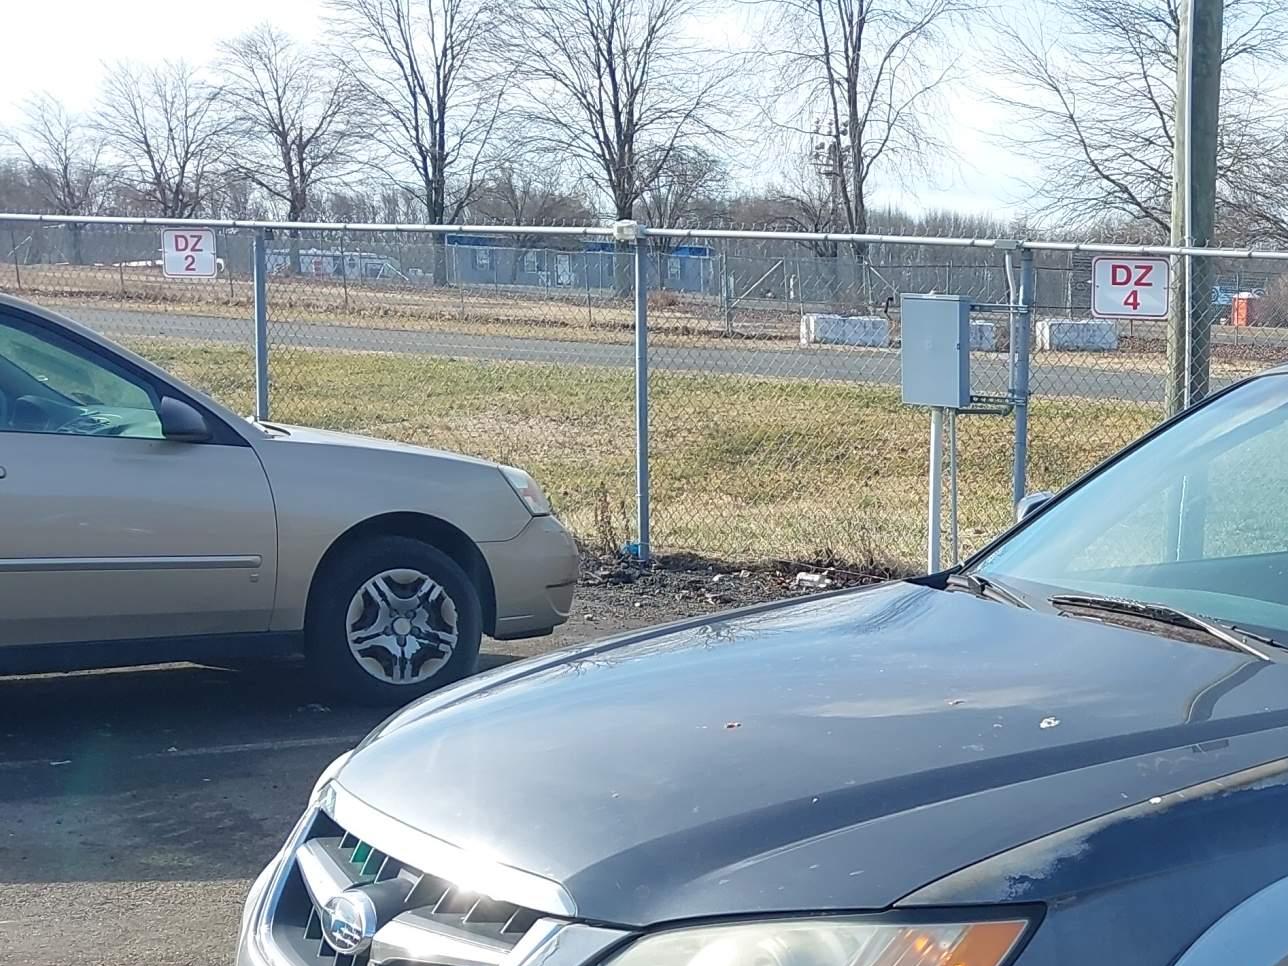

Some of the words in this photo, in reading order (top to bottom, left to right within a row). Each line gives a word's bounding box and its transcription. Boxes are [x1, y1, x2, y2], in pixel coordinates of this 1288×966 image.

[174, 234, 204, 252] DZ
[184, 254, 196, 271] 2
[1111, 264, 1153, 287] DZ
[1123, 289, 1140, 311] 4
